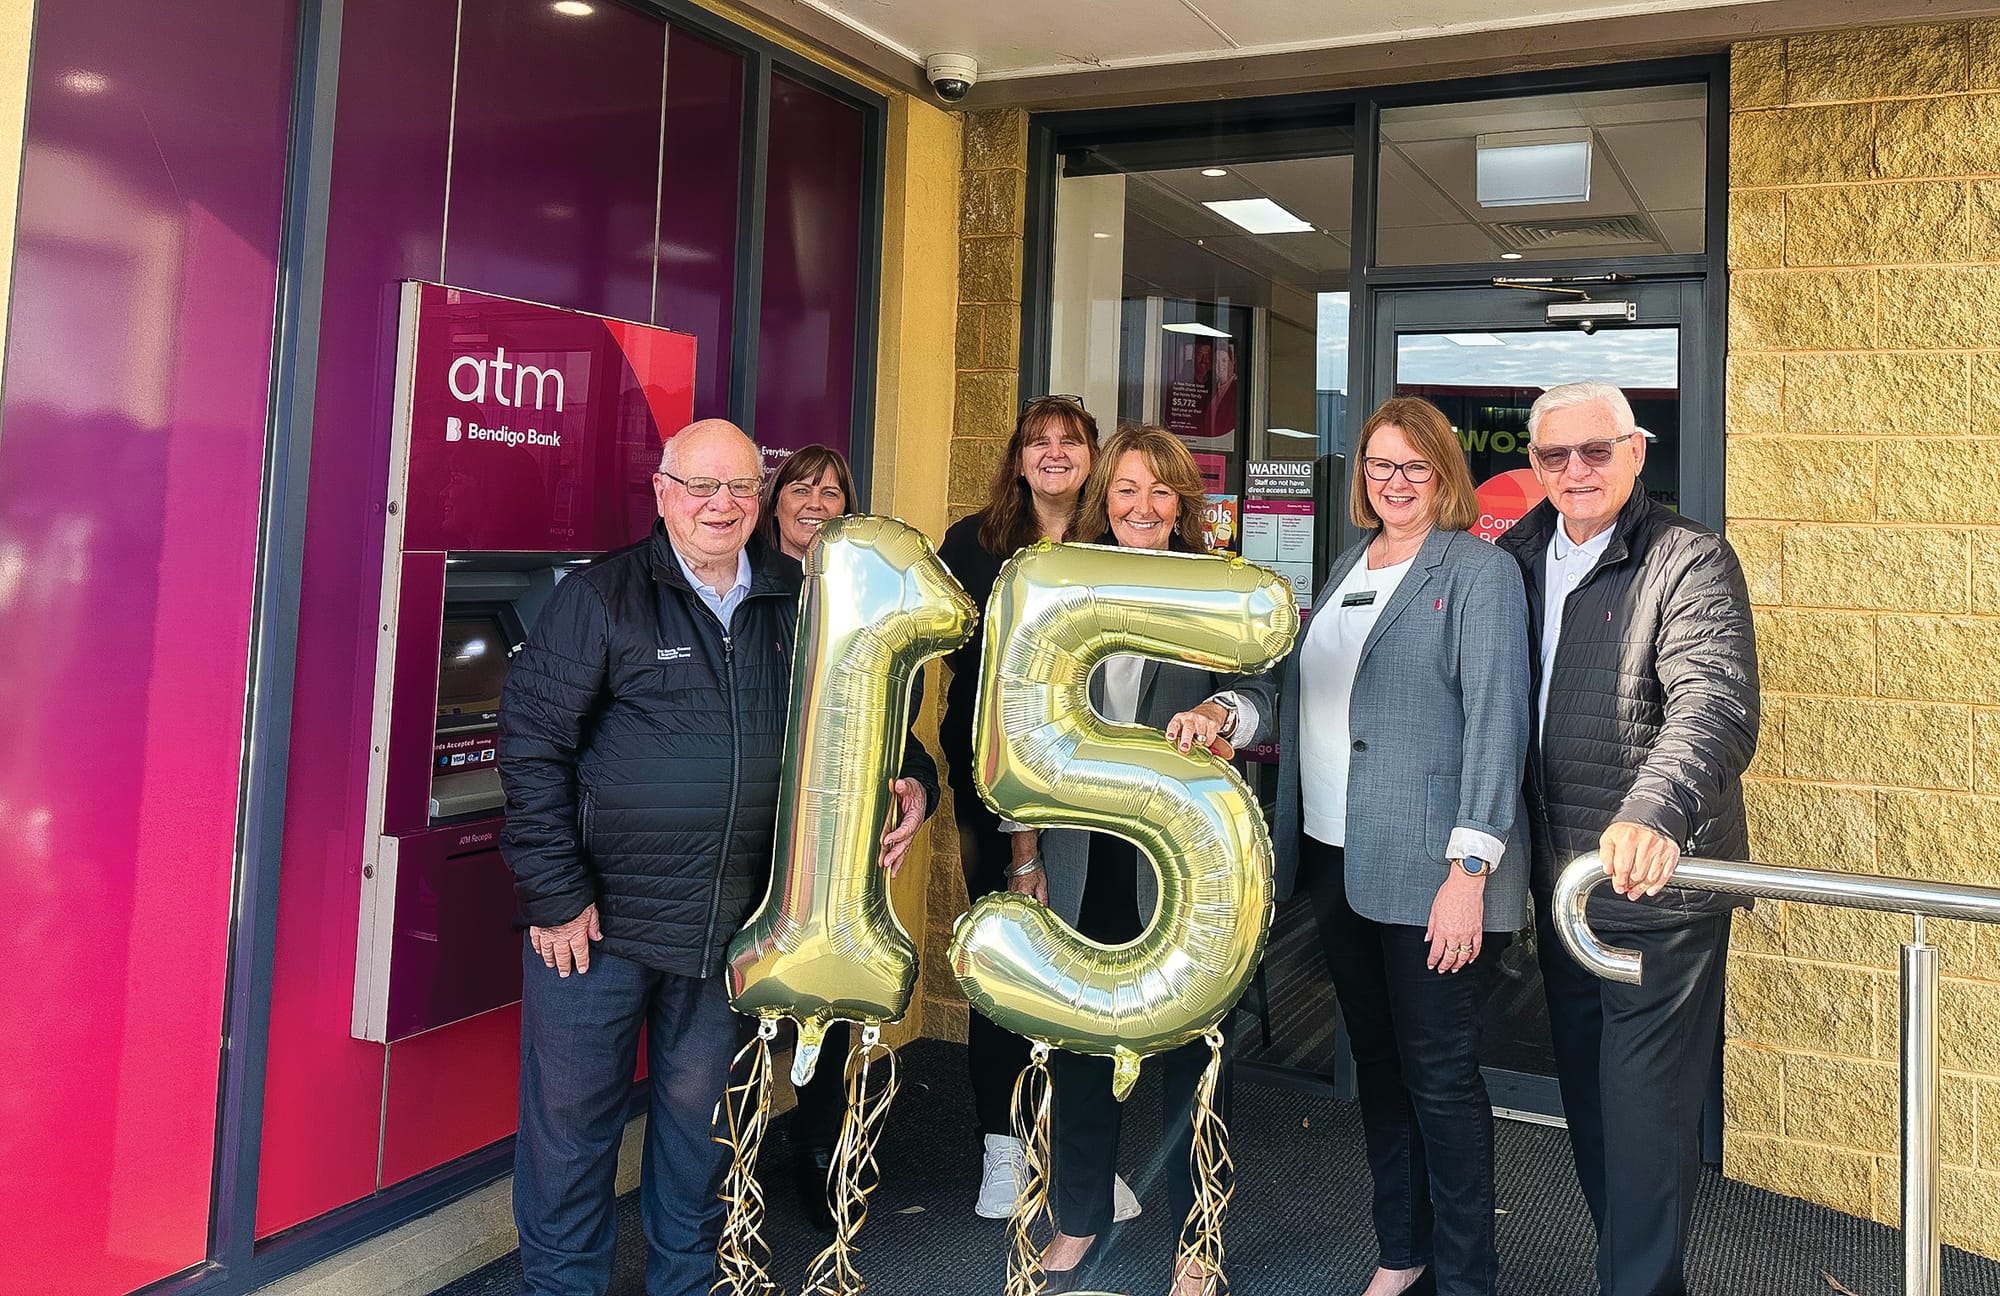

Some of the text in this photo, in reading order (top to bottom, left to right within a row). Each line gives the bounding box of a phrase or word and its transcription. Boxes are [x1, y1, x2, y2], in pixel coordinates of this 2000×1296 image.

[447, 346, 565, 413] atm
[1172, 397, 1196, 407] $5,772
[467, 423, 561, 448] Bendigo Bank
[761, 445, 794, 459] Everythin
[1248, 463, 1311, 476] WARNING
[1248, 486, 1265, 494] direct
[1205, 503, 1232, 524] ols
[1479, 514, 1519, 530] Com
[446, 739, 475, 749] Accepted
[459, 835, 471, 845] ATM
